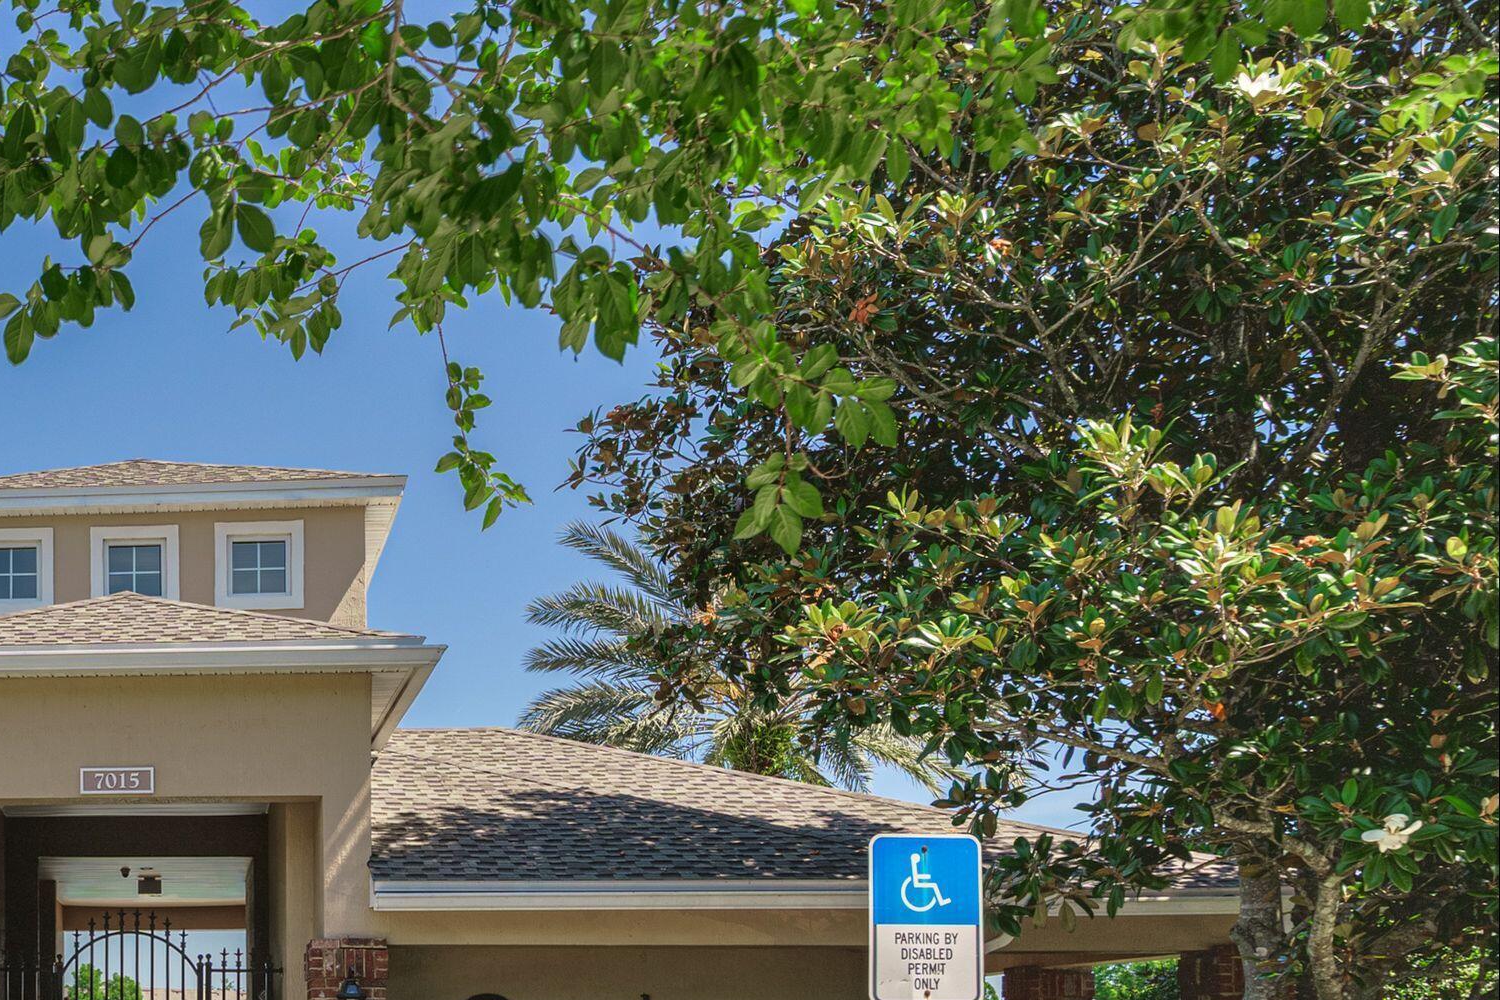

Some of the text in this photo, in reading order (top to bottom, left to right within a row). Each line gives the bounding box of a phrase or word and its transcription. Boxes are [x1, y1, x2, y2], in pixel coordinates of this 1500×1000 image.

[94, 772, 140, 789] 7015
[894, 932, 959, 946] PARKING BY
[900, 947, 953, 961] DISABLED
[907, 962, 946, 976] PERMIT
[913, 977, 941, 991] ONLY
